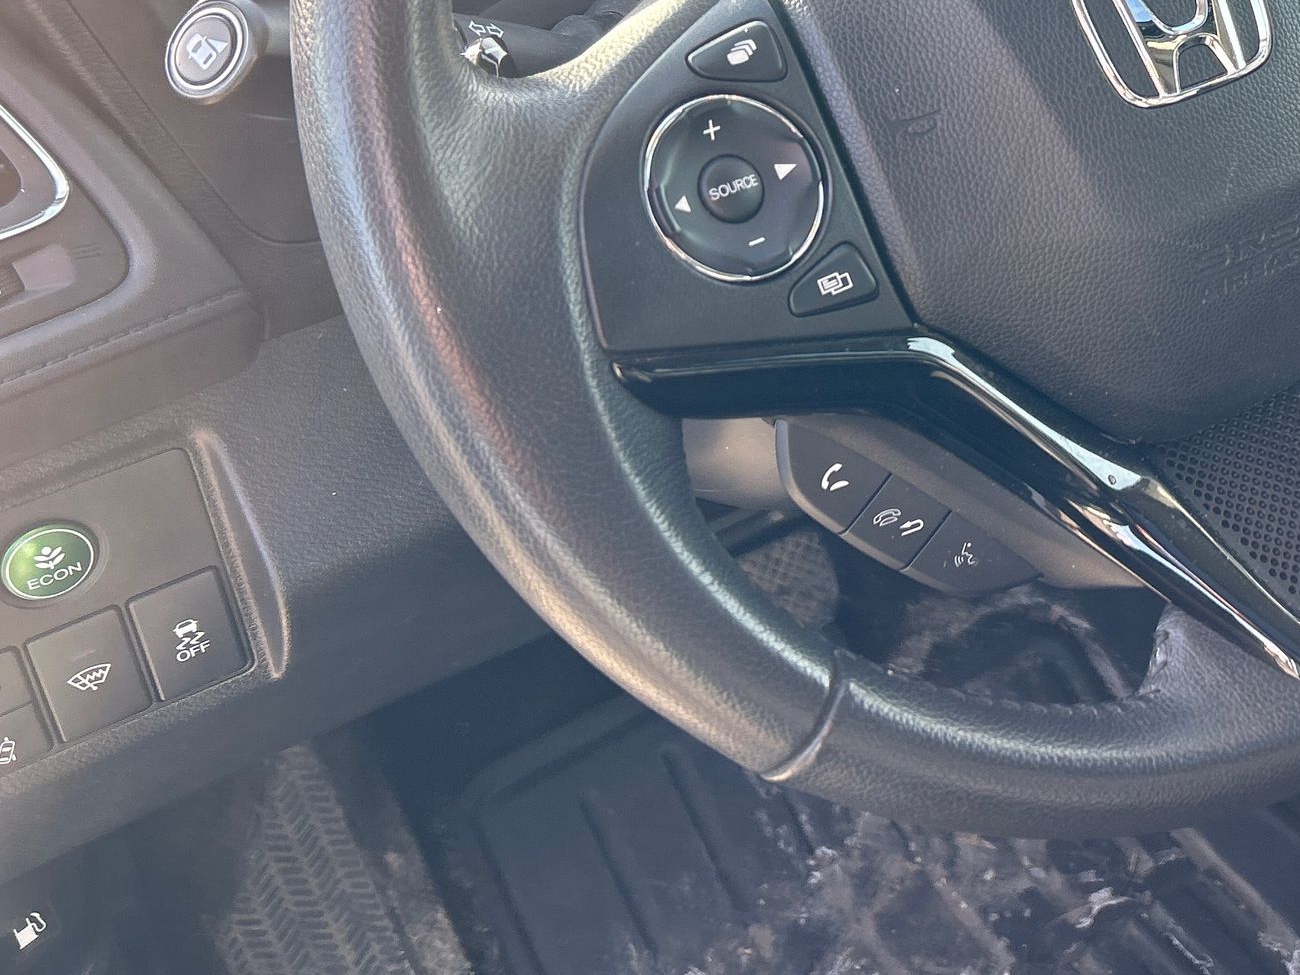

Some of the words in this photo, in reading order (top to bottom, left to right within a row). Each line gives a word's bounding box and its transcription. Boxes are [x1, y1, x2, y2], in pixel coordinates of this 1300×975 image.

[708, 174, 759, 200] SOURCE
[27, 561, 83, 591] ECON
[176, 640, 210, 662] OFF
